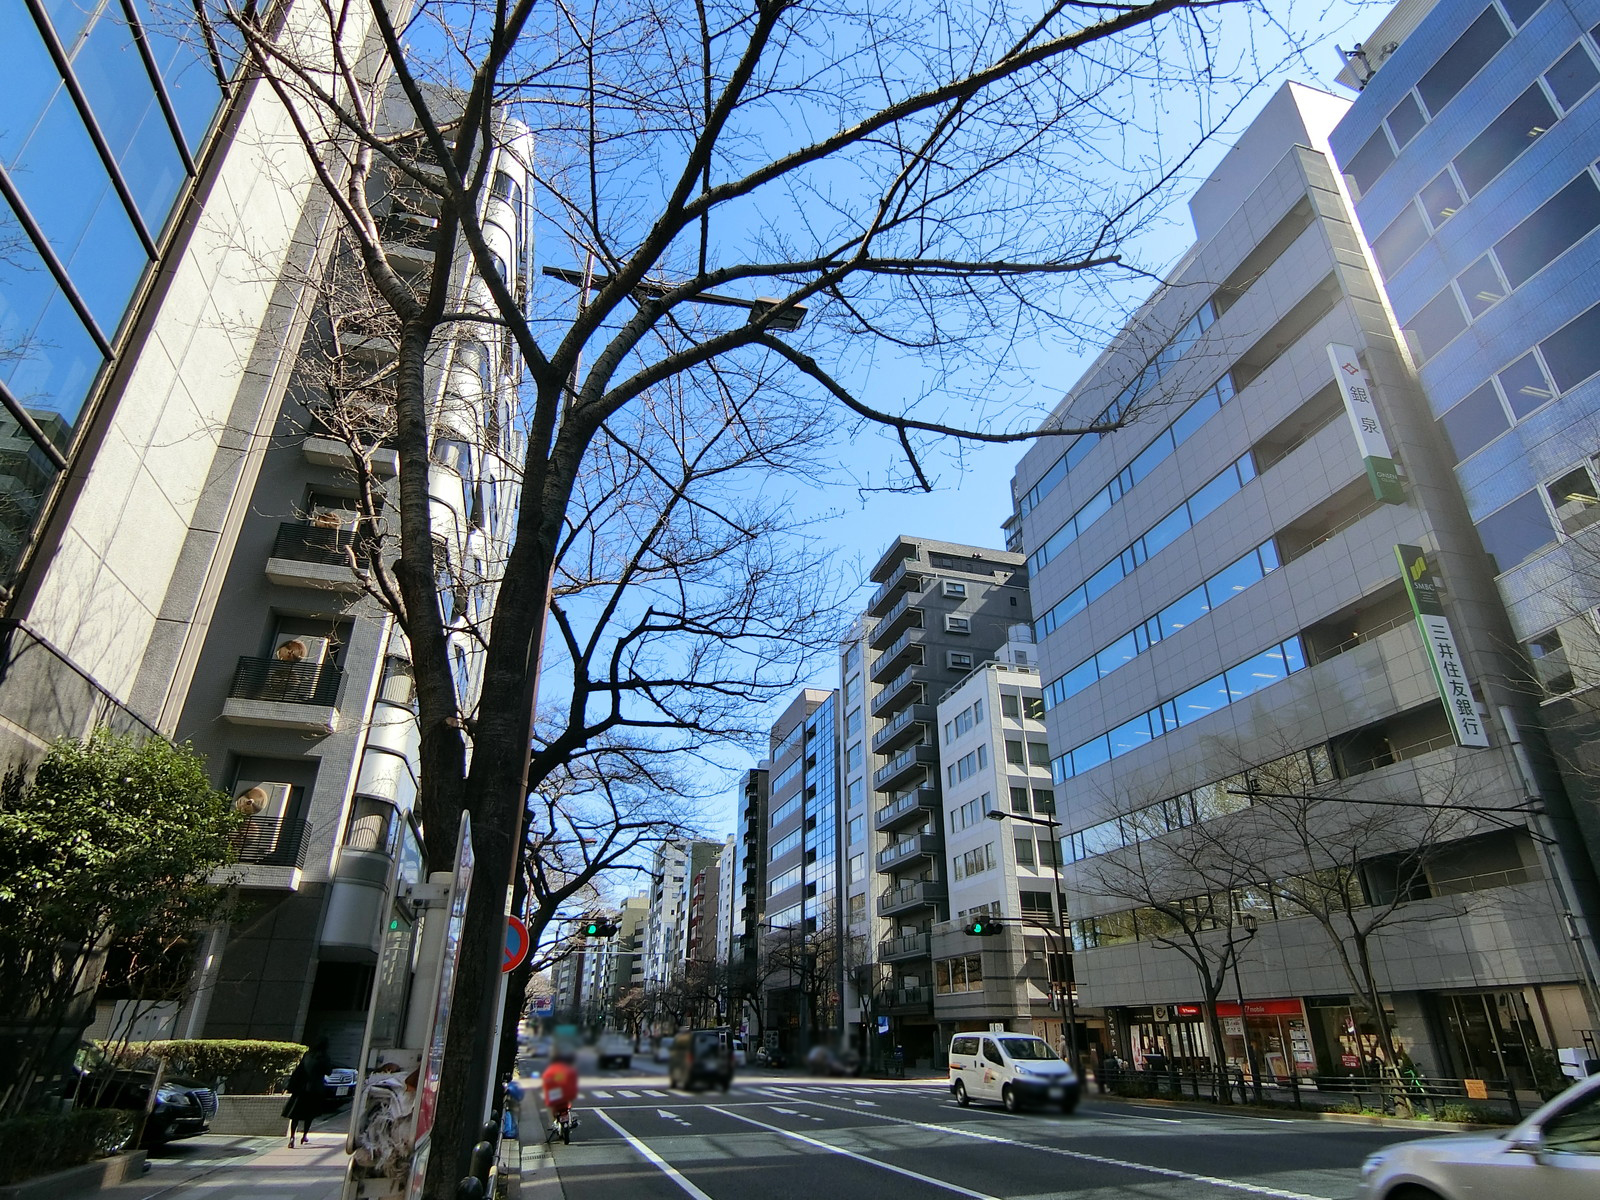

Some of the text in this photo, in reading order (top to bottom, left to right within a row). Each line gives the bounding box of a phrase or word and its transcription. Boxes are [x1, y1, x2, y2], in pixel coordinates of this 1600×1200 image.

[1350, 385, 1380, 435] 銀泉
[1413, 581, 1435, 591] SMBC
[1430, 624, 1479, 736] 三井住友銀行
